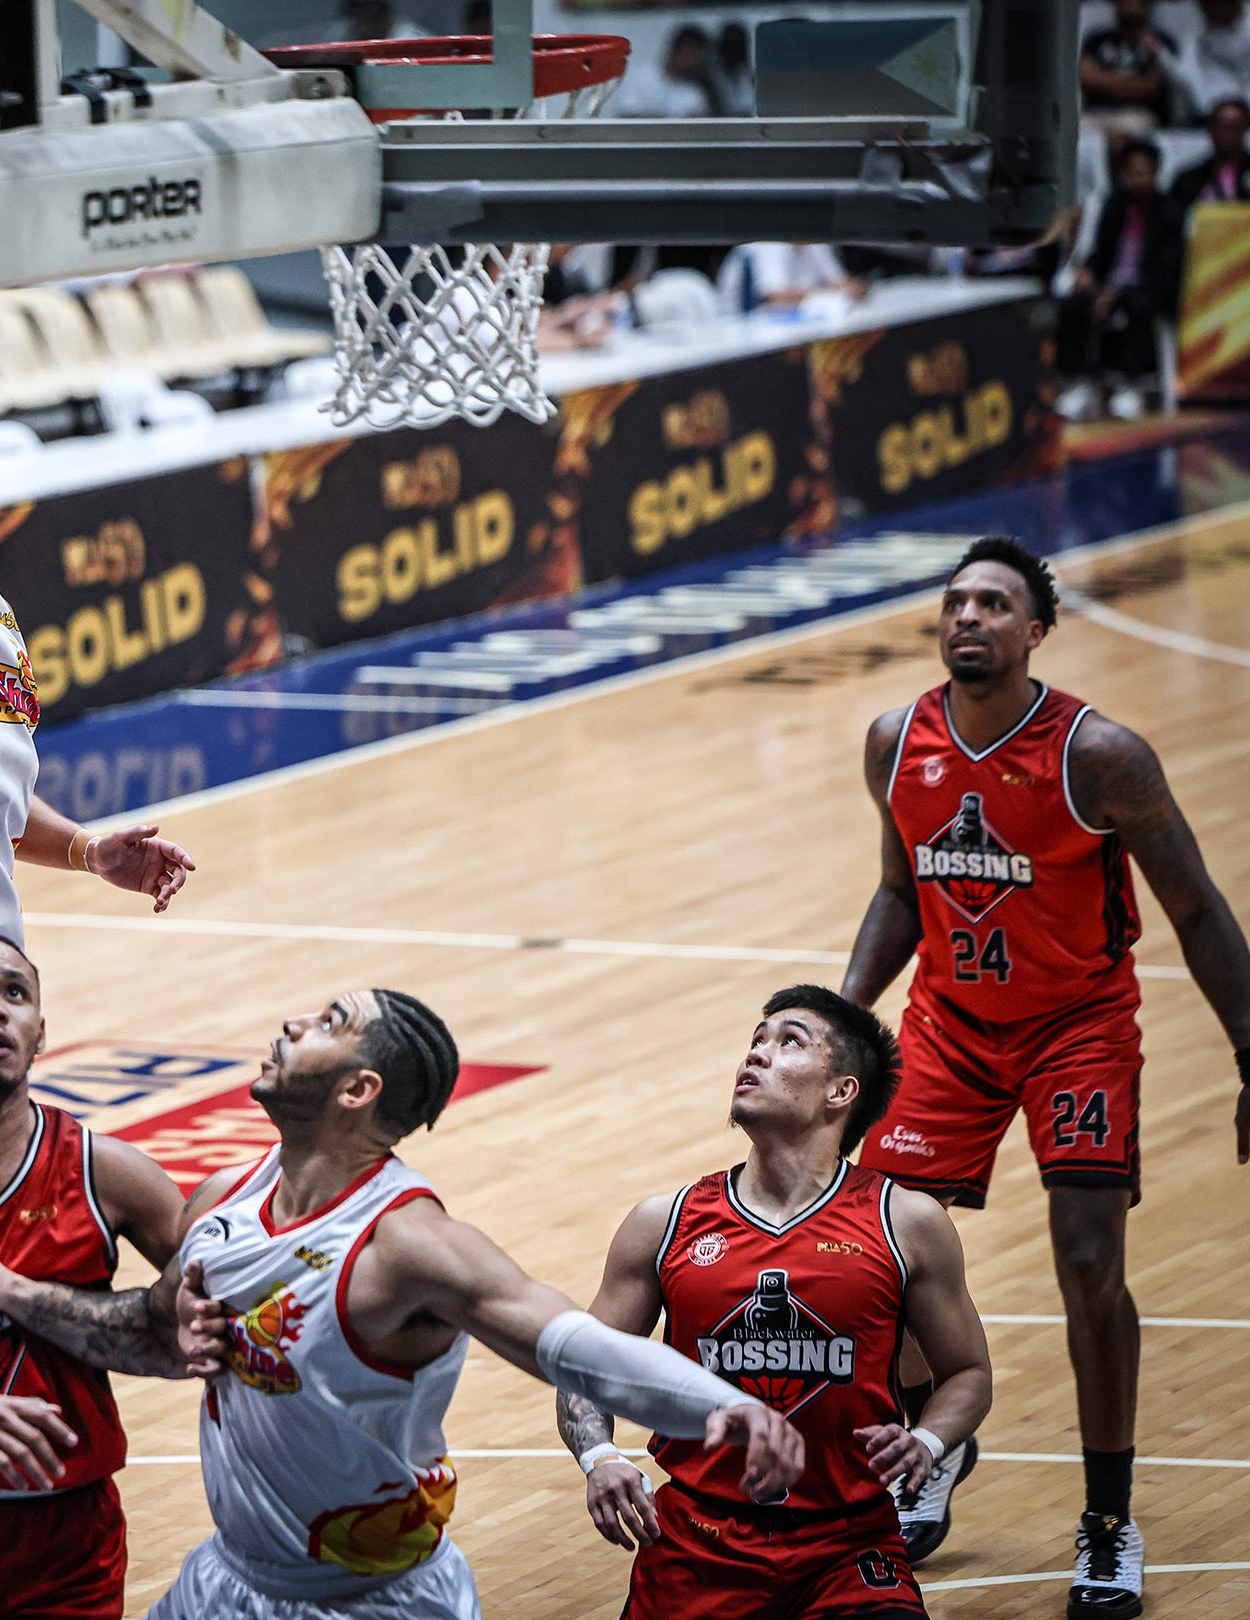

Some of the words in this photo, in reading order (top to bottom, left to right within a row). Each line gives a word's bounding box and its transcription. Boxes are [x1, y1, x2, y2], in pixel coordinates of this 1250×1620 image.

[879, 381, 1012, 492] SOLID
[628, 430, 775, 555] SOLID
[337, 489, 514, 622] SOLID
[27, 562, 206, 706] SOLID
[915, 845, 1033, 884] BOSSING
[950, 928, 1013, 984] 24
[1052, 1090, 1112, 1148] 24
[697, 1336, 854, 1377] BOSSING
[733, 1326, 816, 1341] Blackwater
